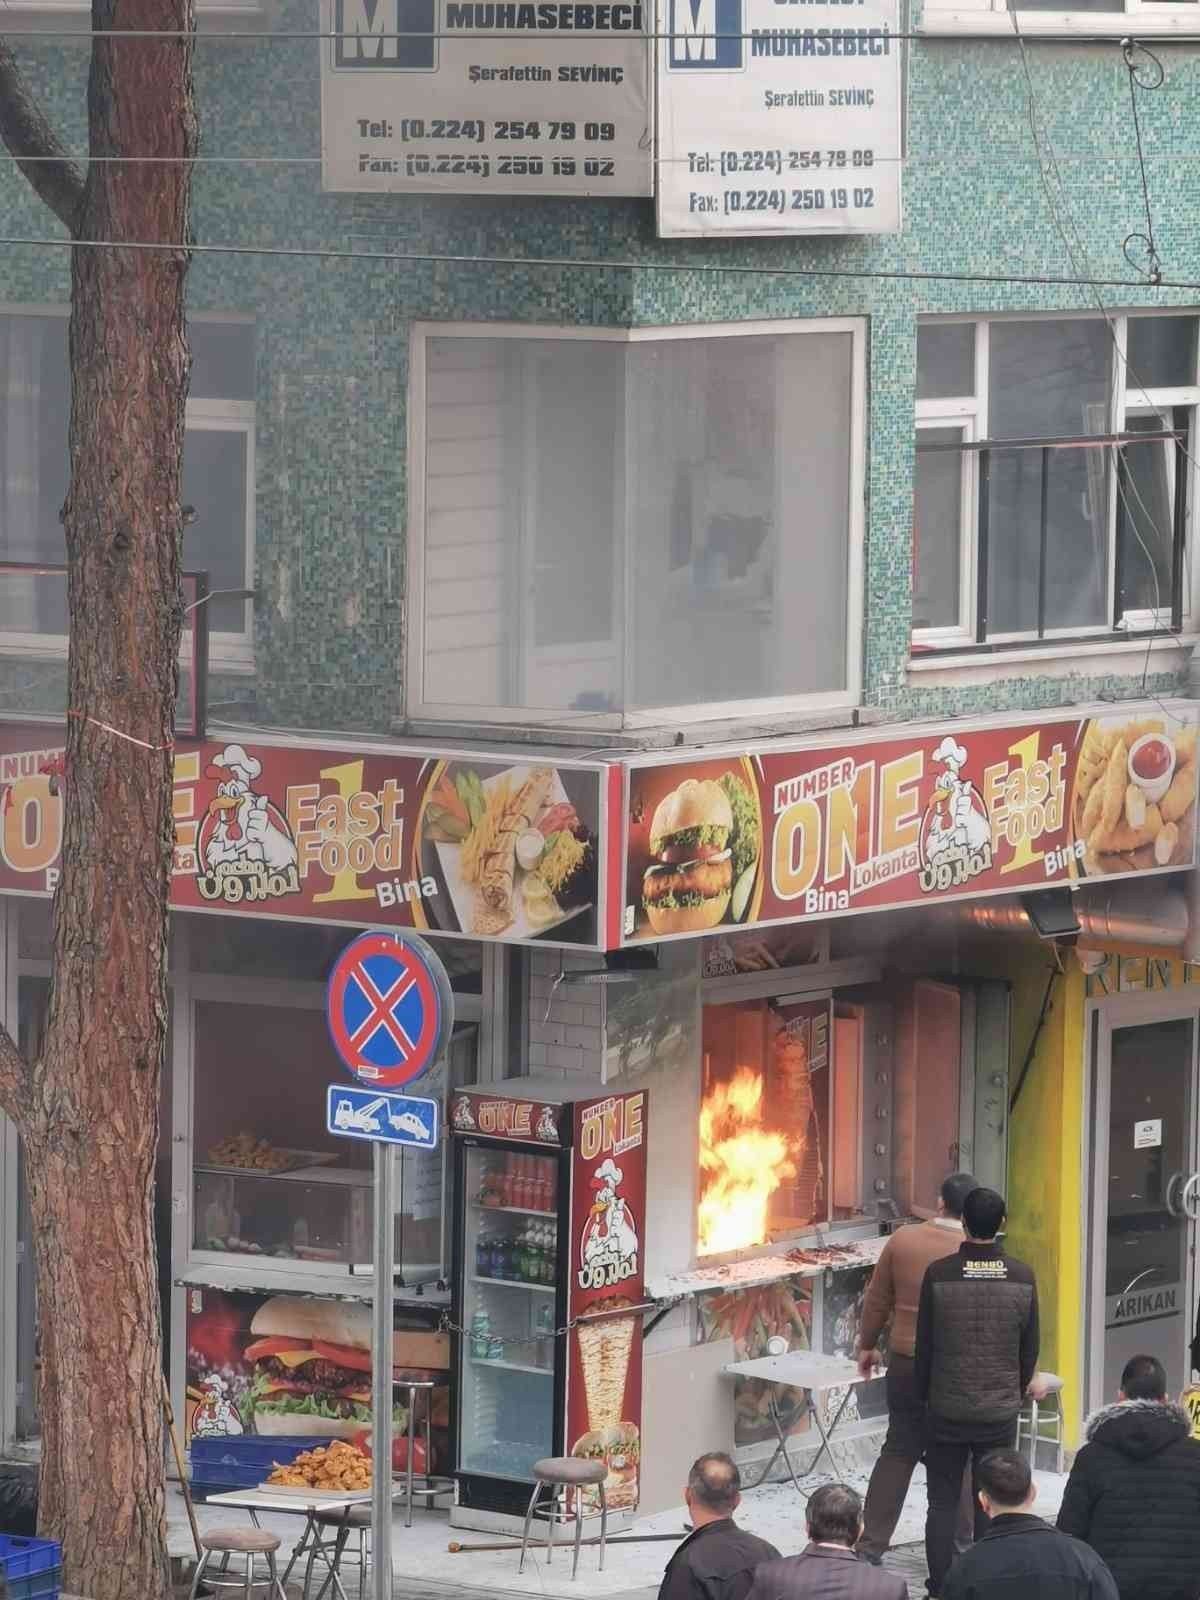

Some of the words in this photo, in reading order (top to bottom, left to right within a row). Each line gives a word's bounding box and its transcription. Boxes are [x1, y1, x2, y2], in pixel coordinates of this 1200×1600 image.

[447, 0, 642, 30] MUHASEBECİ
[751, 22, 889, 57] MUHASEBECİ
[468, 65, 552, 84] Şerafettin
[558, 64, 624, 85] SEVİNÇ
[765, 90, 825, 110] Şerafettin
[829, 85, 874, 109] SEVİNÇ
[357, 119, 393, 138] Tel:
[494, 121, 541, 141] 254
[548, 121, 576, 141] 79
[584, 122, 615, 141] 09
[497, 155, 543, 175] 250
[552, 156, 576, 176] 19
[584, 156, 615, 176] 02
[688, 151, 715, 172] Tel:
[789, 151, 821, 169] 254
[689, 191, 719, 213] Fax:
[791, 189, 825, 210] 250
[830, 189, 848, 208] 19
[853, 188, 874, 208] 02
[775, 760, 854, 811] NUMBER
[984, 743, 1067, 810] Fast
[286, 778, 404, 836] Fast
[991, 779, 1066, 854] Food
[772, 750, 924, 900] ONE
[296, 818, 404, 878] Food
[1044, 839, 1087, 877] Bina
[853, 848, 918, 889] Lokanta
[376, 876, 438, 908] Bina
[805, 886, 850, 913] Bina
[479, 1103, 533, 1133] ONE
[581, 1093, 644, 1160] ONE
[1114, 1289, 1176, 1318] ARIKAN
